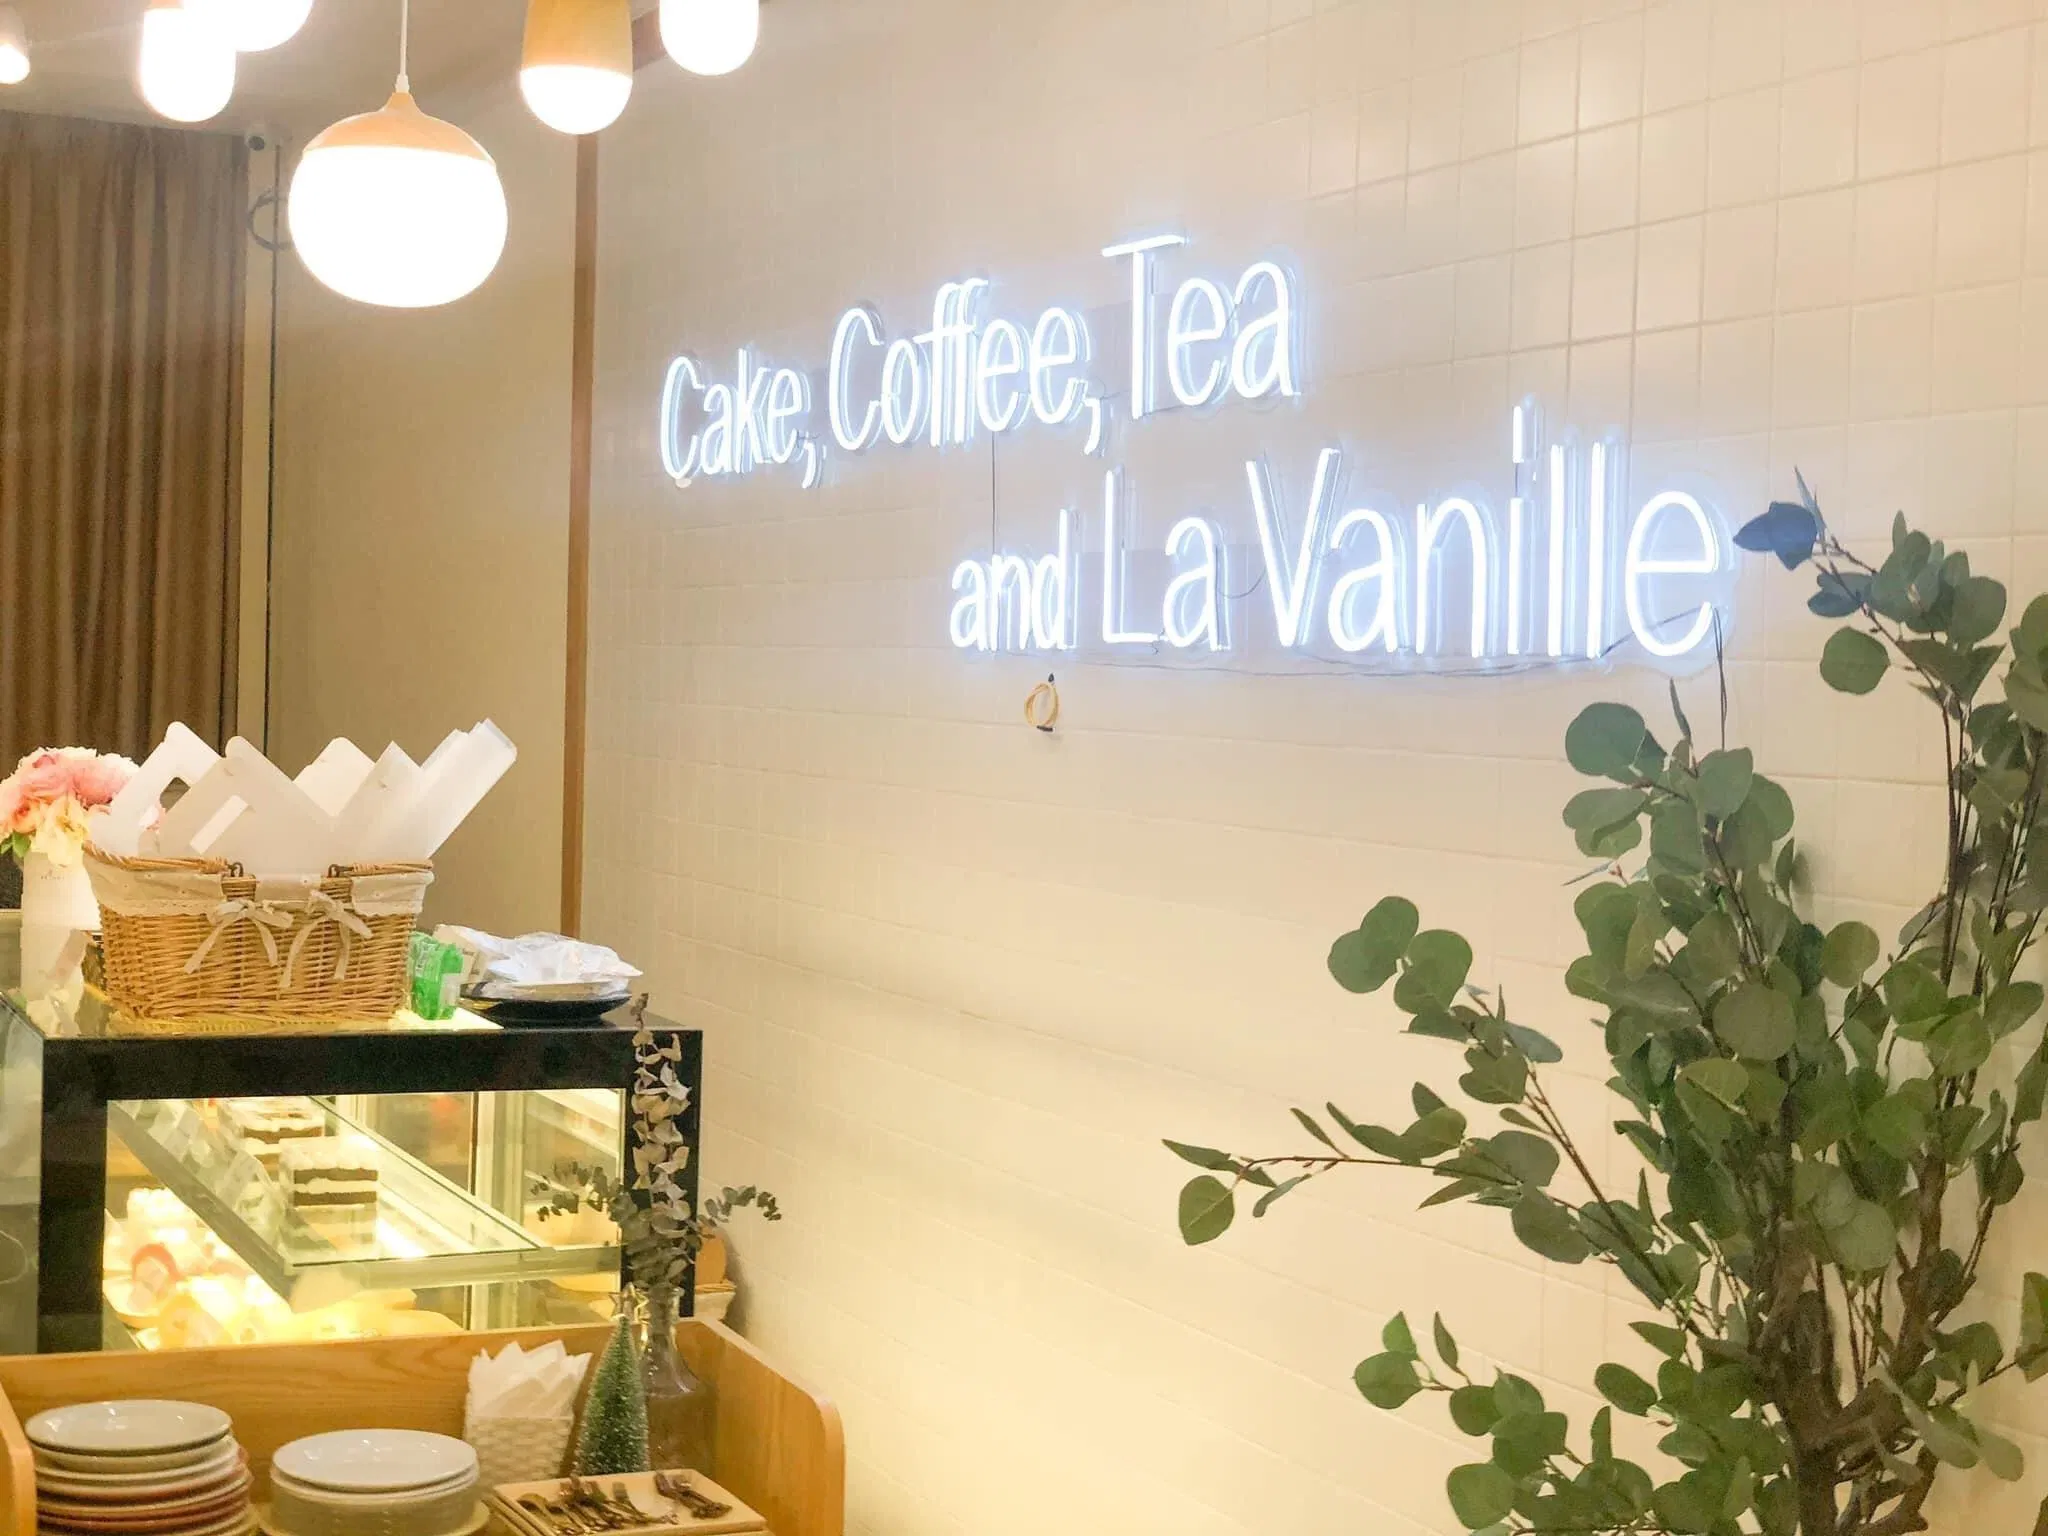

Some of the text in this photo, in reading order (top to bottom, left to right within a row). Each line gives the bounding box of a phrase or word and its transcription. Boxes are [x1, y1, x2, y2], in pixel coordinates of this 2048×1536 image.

[660, 234, 1300, 488] Cake, Coffee, Tea
[950, 405, 1720, 657] and La Vanille
